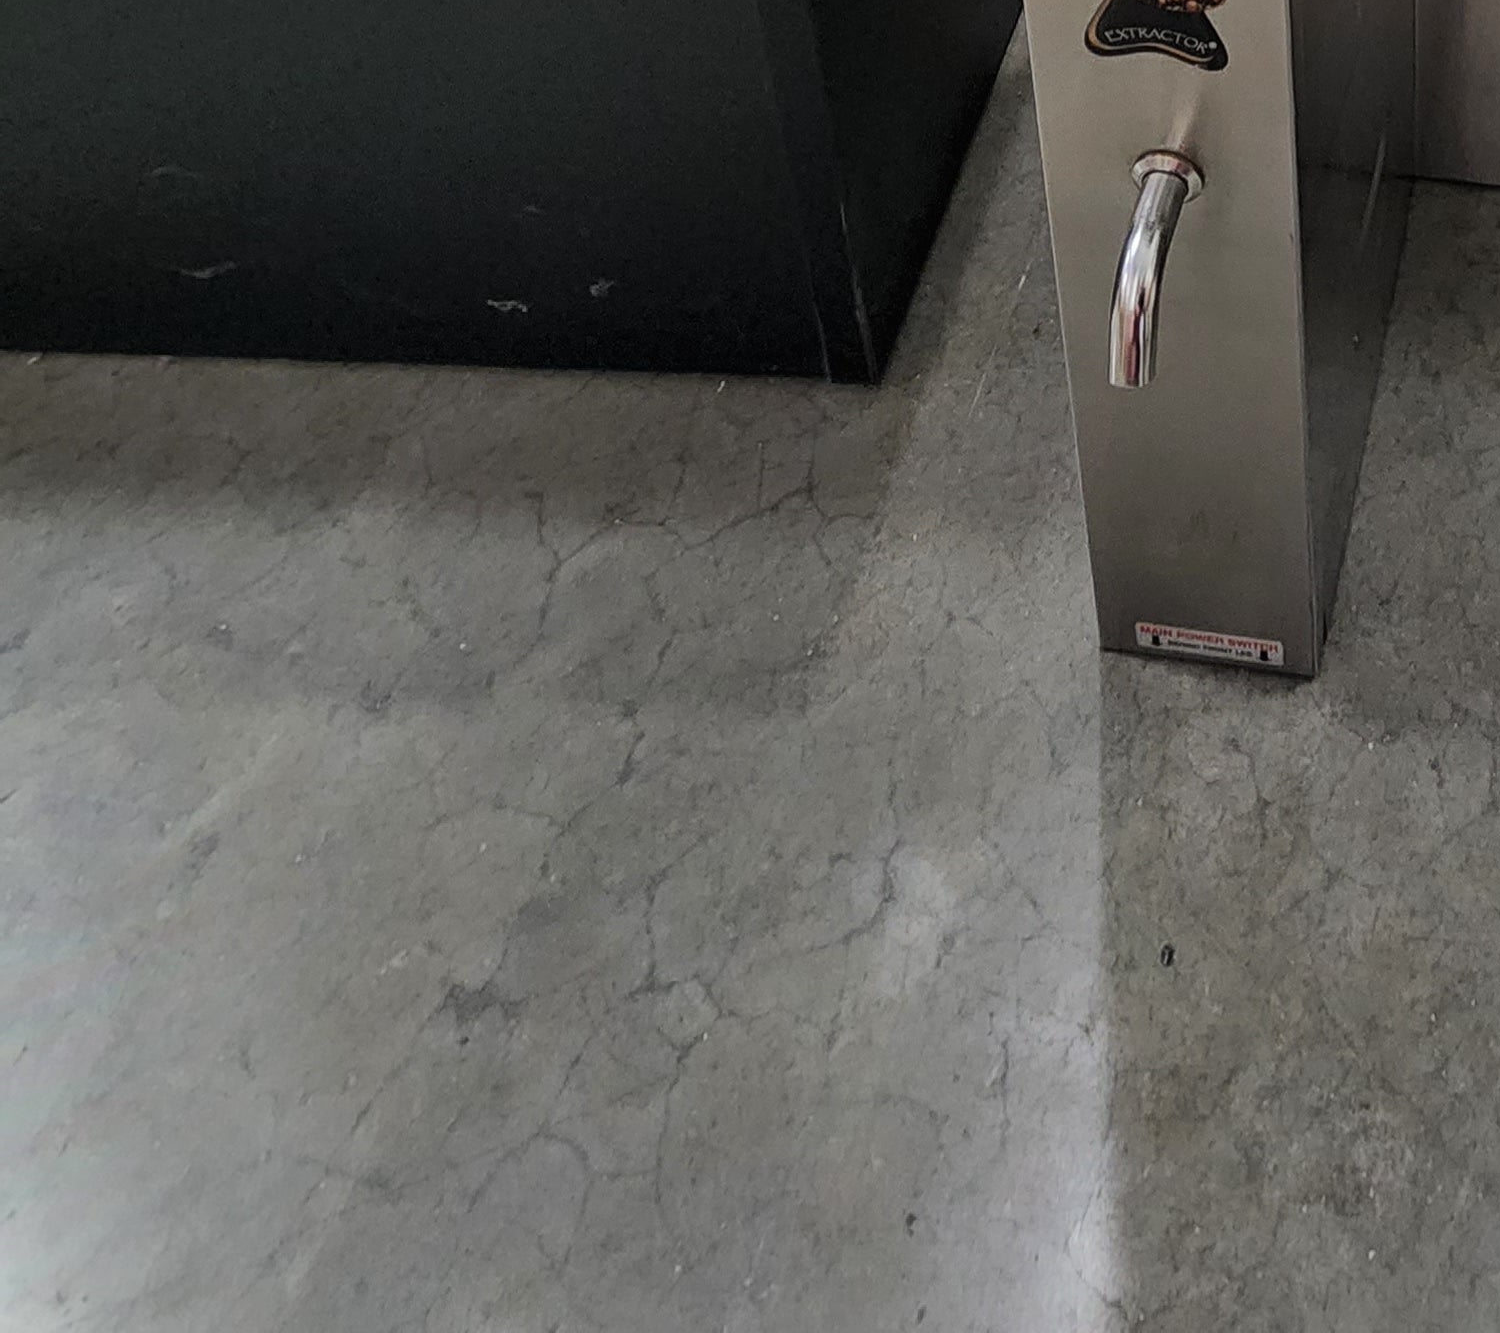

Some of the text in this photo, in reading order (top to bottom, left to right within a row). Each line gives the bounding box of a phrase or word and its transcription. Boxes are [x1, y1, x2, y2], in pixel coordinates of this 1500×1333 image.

[1104, 27, 1208, 54] EXTRACTOR
[1140, 625, 1278, 652] MAIN POWER SWITCH
